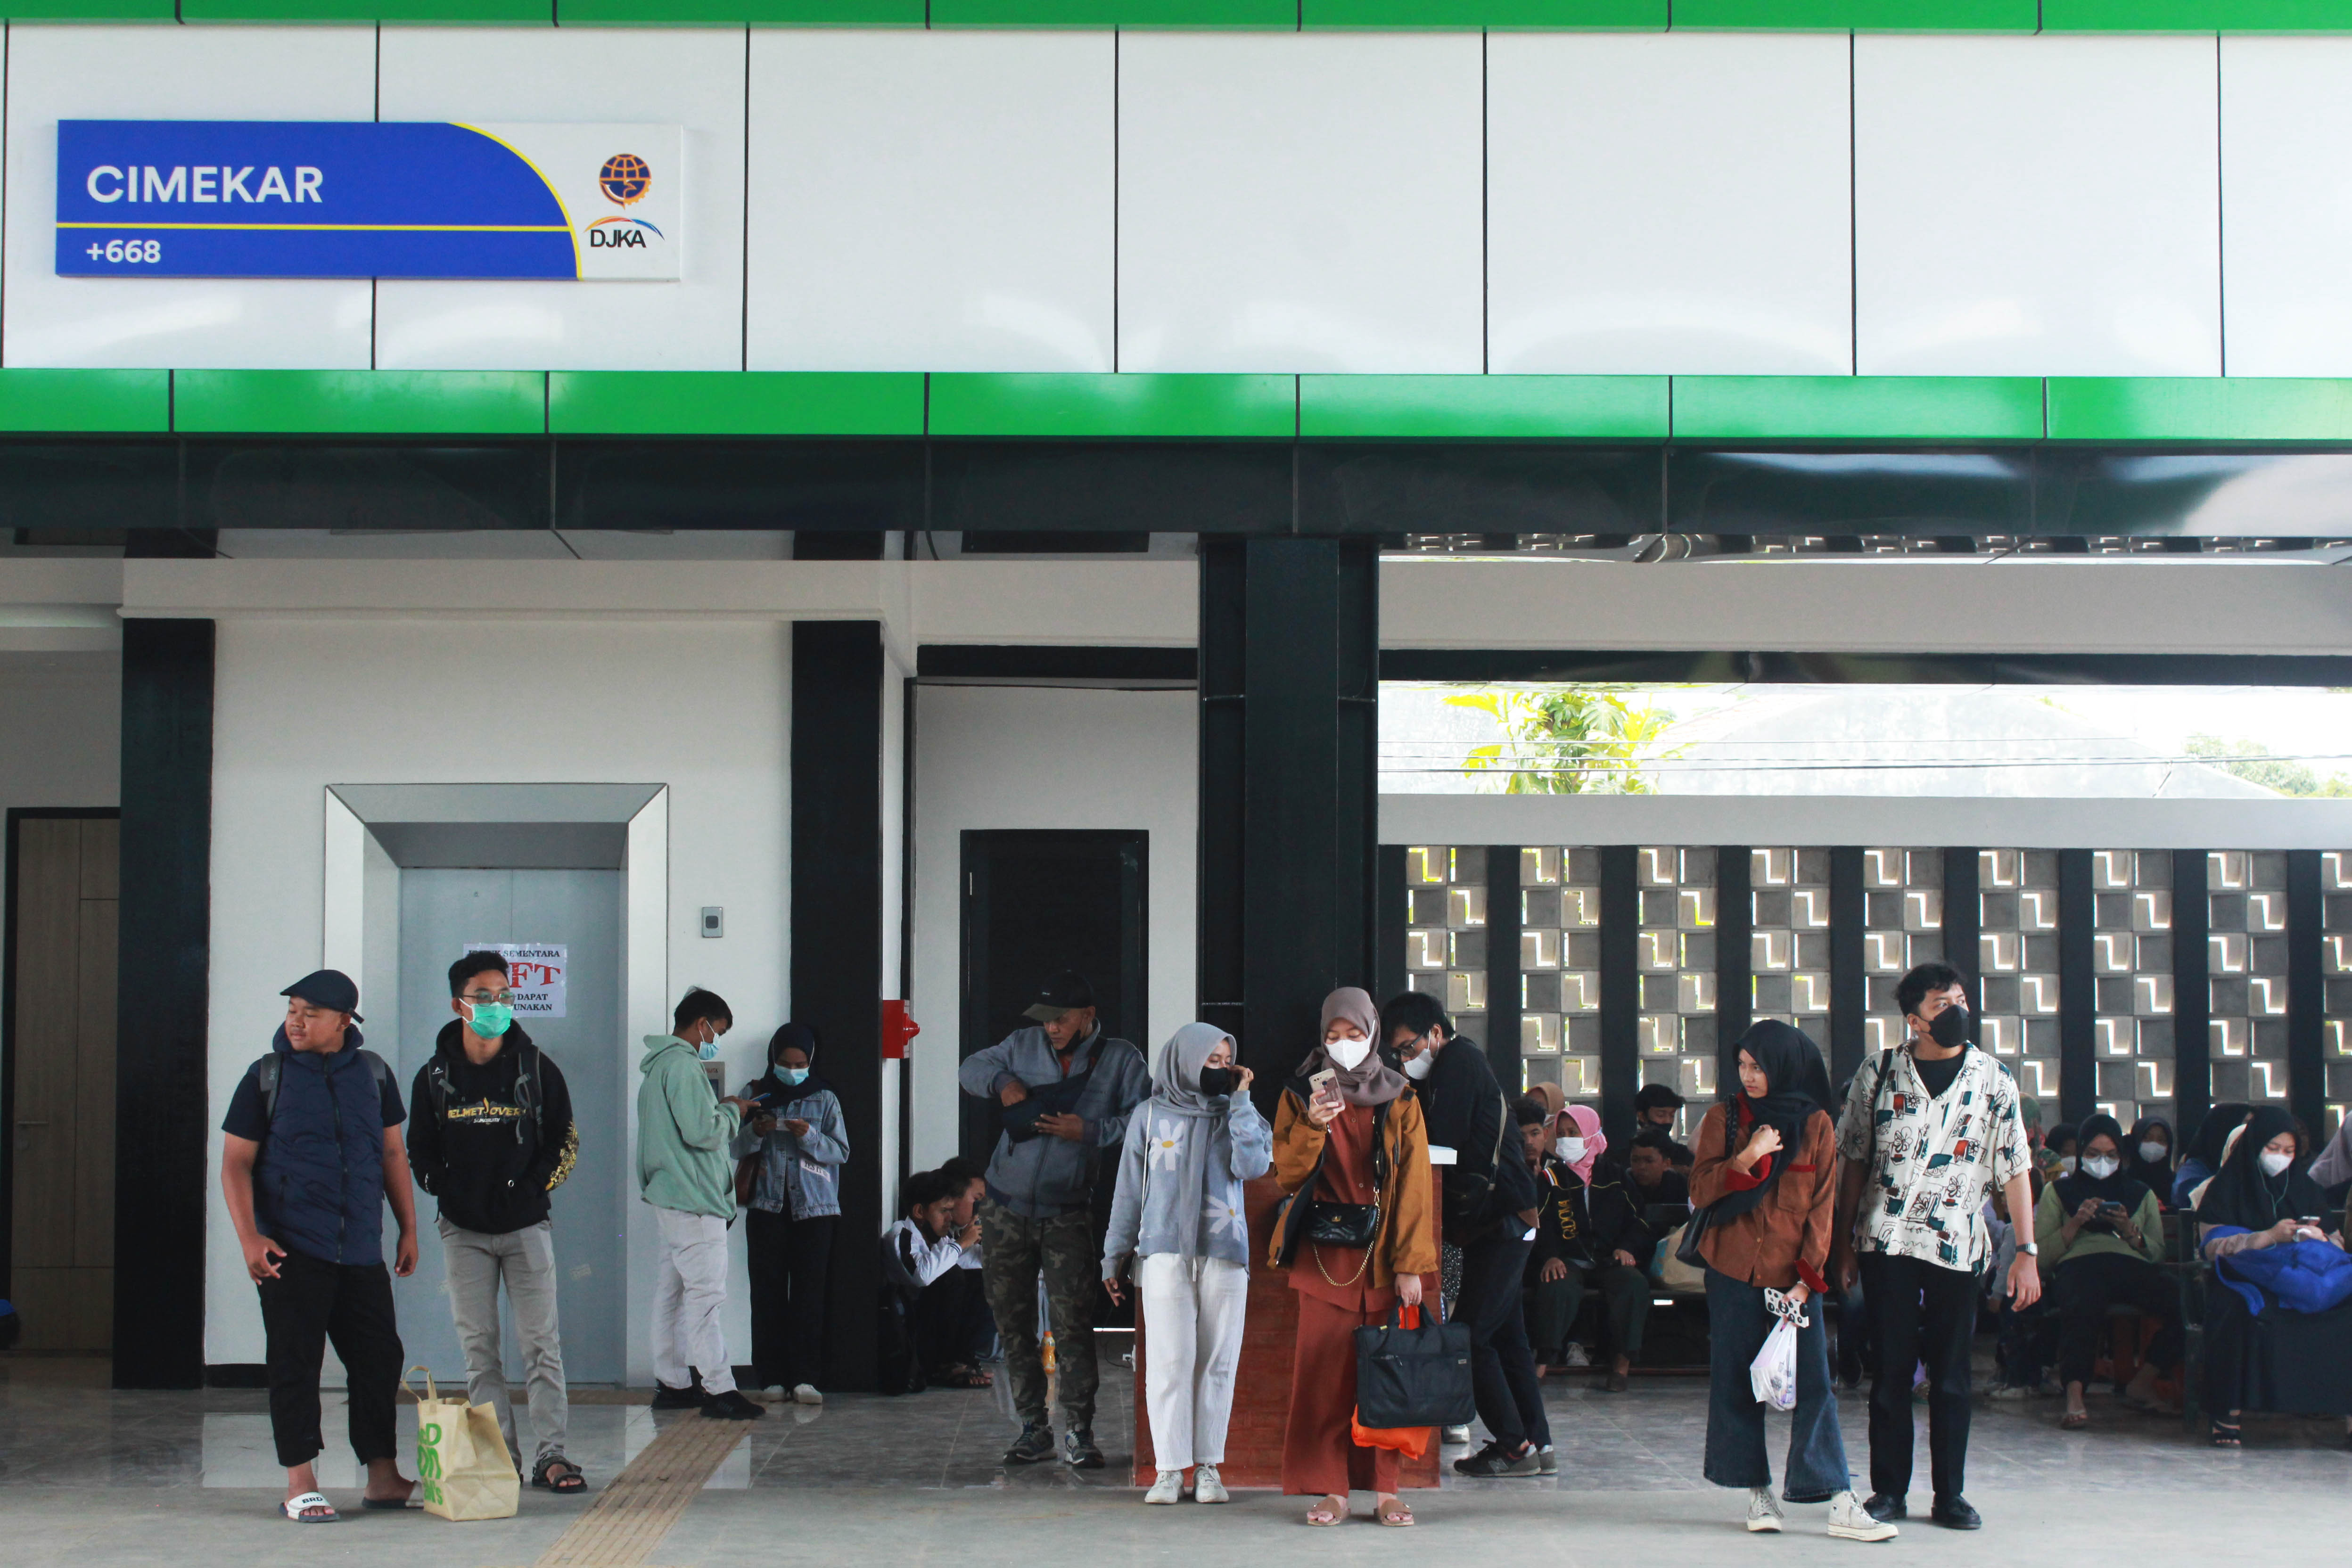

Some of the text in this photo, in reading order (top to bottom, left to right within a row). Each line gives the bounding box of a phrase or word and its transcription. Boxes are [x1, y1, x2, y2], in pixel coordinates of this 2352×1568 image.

[87, 165, 323, 203] CIMEKAR
[86, 239, 161, 263] +668
[591, 230, 646, 248] DJKA
[509, 962, 560, 988] FT
